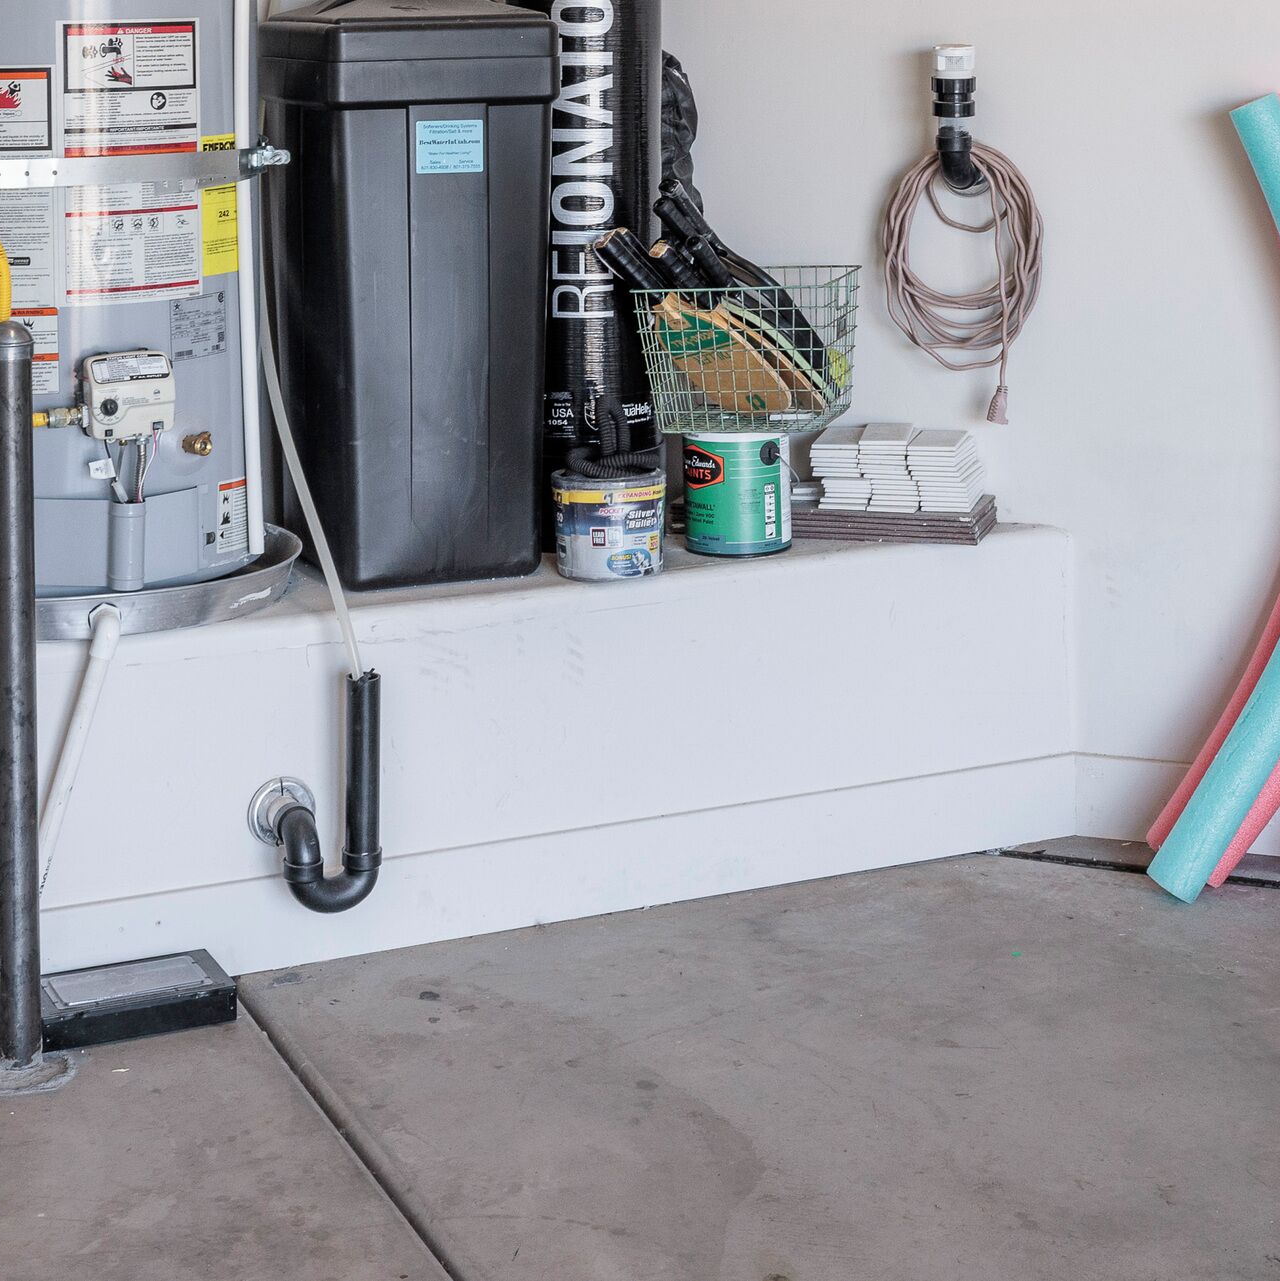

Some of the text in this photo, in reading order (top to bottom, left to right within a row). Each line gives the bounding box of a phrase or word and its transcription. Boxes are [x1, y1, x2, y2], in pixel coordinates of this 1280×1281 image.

[218, 210, 230, 218] 242
[552, 408, 574, 418] USA
[692, 456, 716, 468] Edwards
[688, 468, 712, 480] INTS
[620, 490, 652, 500] EXPANDING
[628, 508, 656, 519] Silver
[628, 517, 656, 528] Bullet
